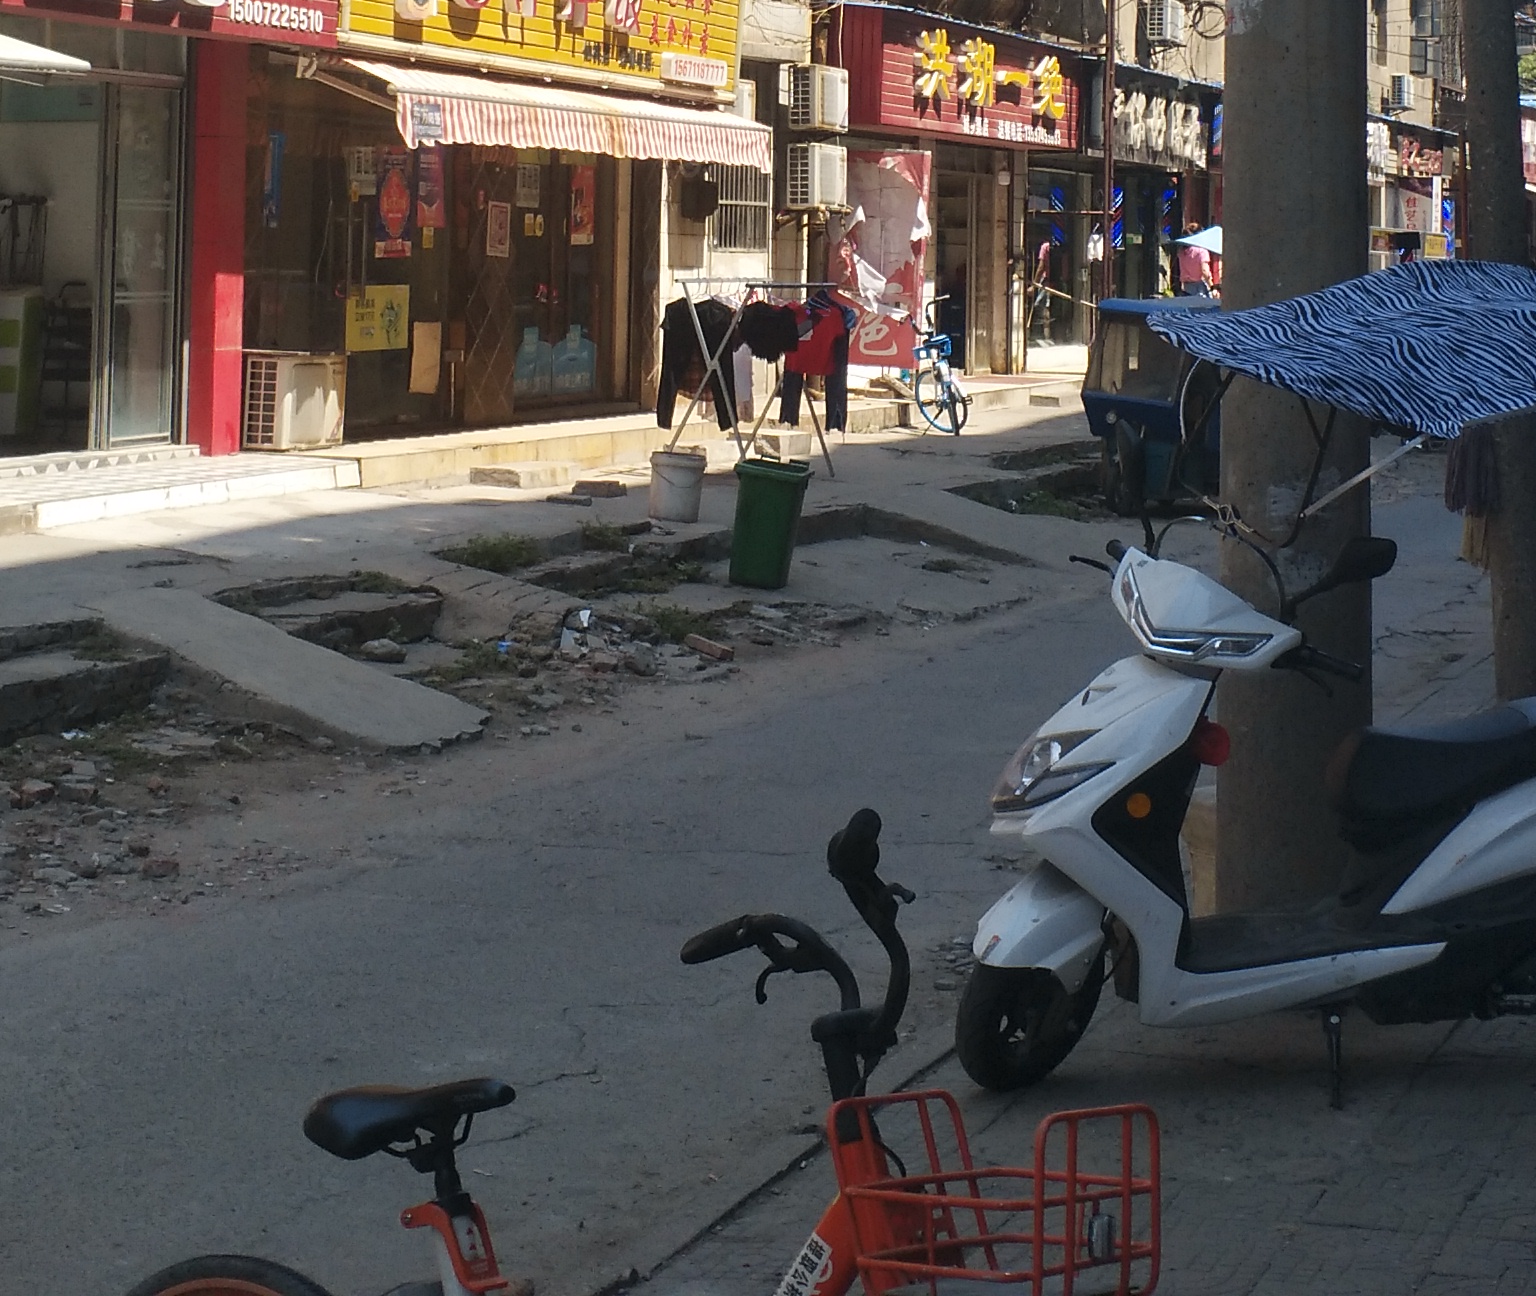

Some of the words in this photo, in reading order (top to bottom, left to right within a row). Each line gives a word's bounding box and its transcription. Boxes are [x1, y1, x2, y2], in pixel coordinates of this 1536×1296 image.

[674, 59, 725, 82] 15671187777
[914, 28, 1066, 120] 洪湖一绝
